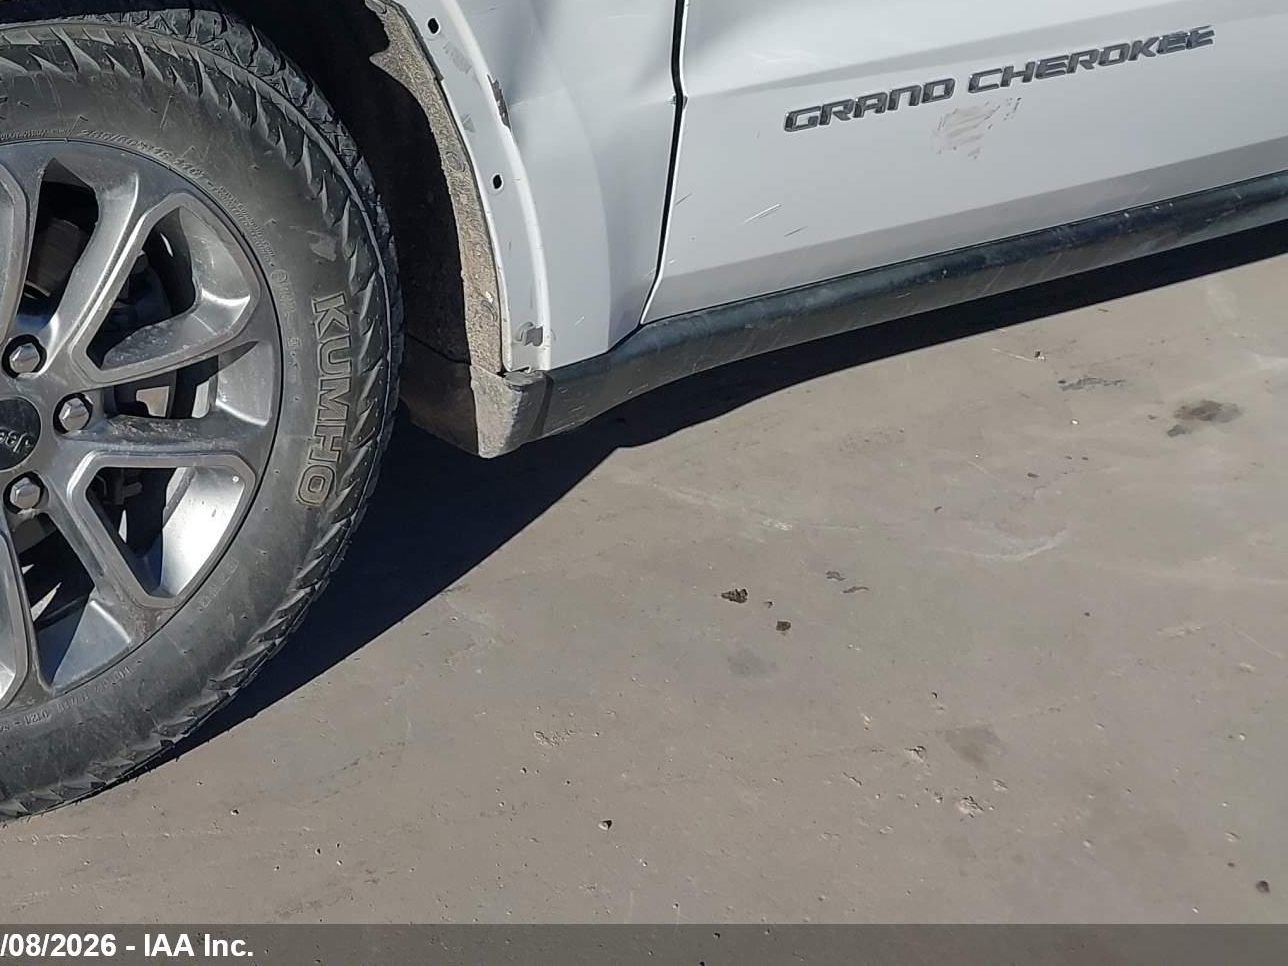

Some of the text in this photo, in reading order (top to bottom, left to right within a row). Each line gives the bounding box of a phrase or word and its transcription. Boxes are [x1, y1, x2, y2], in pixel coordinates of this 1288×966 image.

[784, 25, 1216, 133] GRAND CHEROKEE
[296, 290, 353, 506] KUMHO
